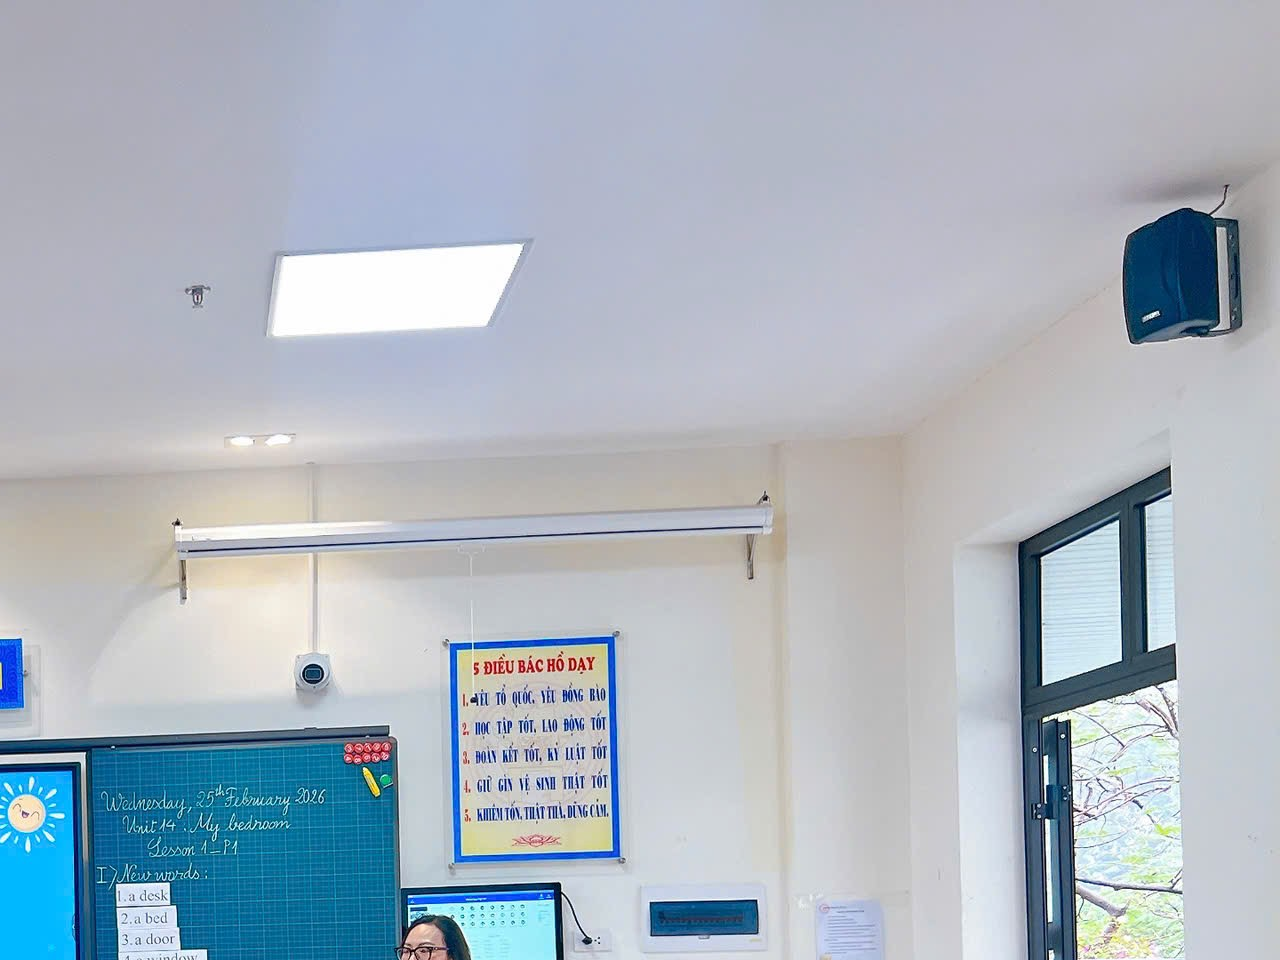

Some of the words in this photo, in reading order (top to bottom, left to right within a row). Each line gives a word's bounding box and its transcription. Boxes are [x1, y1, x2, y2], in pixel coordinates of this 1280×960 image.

[474, 662, 479, 675] 5
[484, 654, 514, 675] ĐIỀU
[518, 656, 544, 673] BÁC
[547, 651, 564, 672] HỒ
[568, 657, 595, 674] DẠY
[475, 689, 488, 706] YÊU
[496, 684, 506, 706] TỔ
[541, 686, 556, 704] YÊU
[562, 682, 584, 703] ĐỒNG
[590, 684, 606, 701] BÀO
[462, 722, 469, 736] 2.
[475, 721, 490, 739] HỌC
[497, 717, 512, 739] TẬP
[542, 719, 558, 732] LAO
[563, 714, 584, 736] ĐỘNG
[591, 710, 606, 730] TỐT
[463, 751, 470, 764] 3.
[475, 746, 496, 764] ĐOÀN
[502, 742, 518, 763] KẾT
[565, 743, 586, 765] LUẬT
[591, 739, 607, 760] TỐT
[464, 780, 471, 793] 4.
[477, 775, 492, 793] GIỮ
[498, 774, 513, 792] GÌN
[520, 774, 530, 795] VỆ
[536, 777, 556, 790] SINH
[562, 772, 585, 794] THẬT
[591, 768, 608, 789] TỐT
[225, 787, 291, 815] February
[295, 788, 326, 805] 2026
[464, 809, 472, 822] 5.
[524, 802, 545, 824] THẬT
[122, 815, 157, 834] Unit
[158, 818, 176, 832] 14
[189, 813, 220, 841] My
[228, 813, 291, 831] bedroom
[117, 864, 152, 883] New
[140, 890, 168, 901] desk
[145, 912, 168, 924] bed
[146, 932, 176, 945] door
